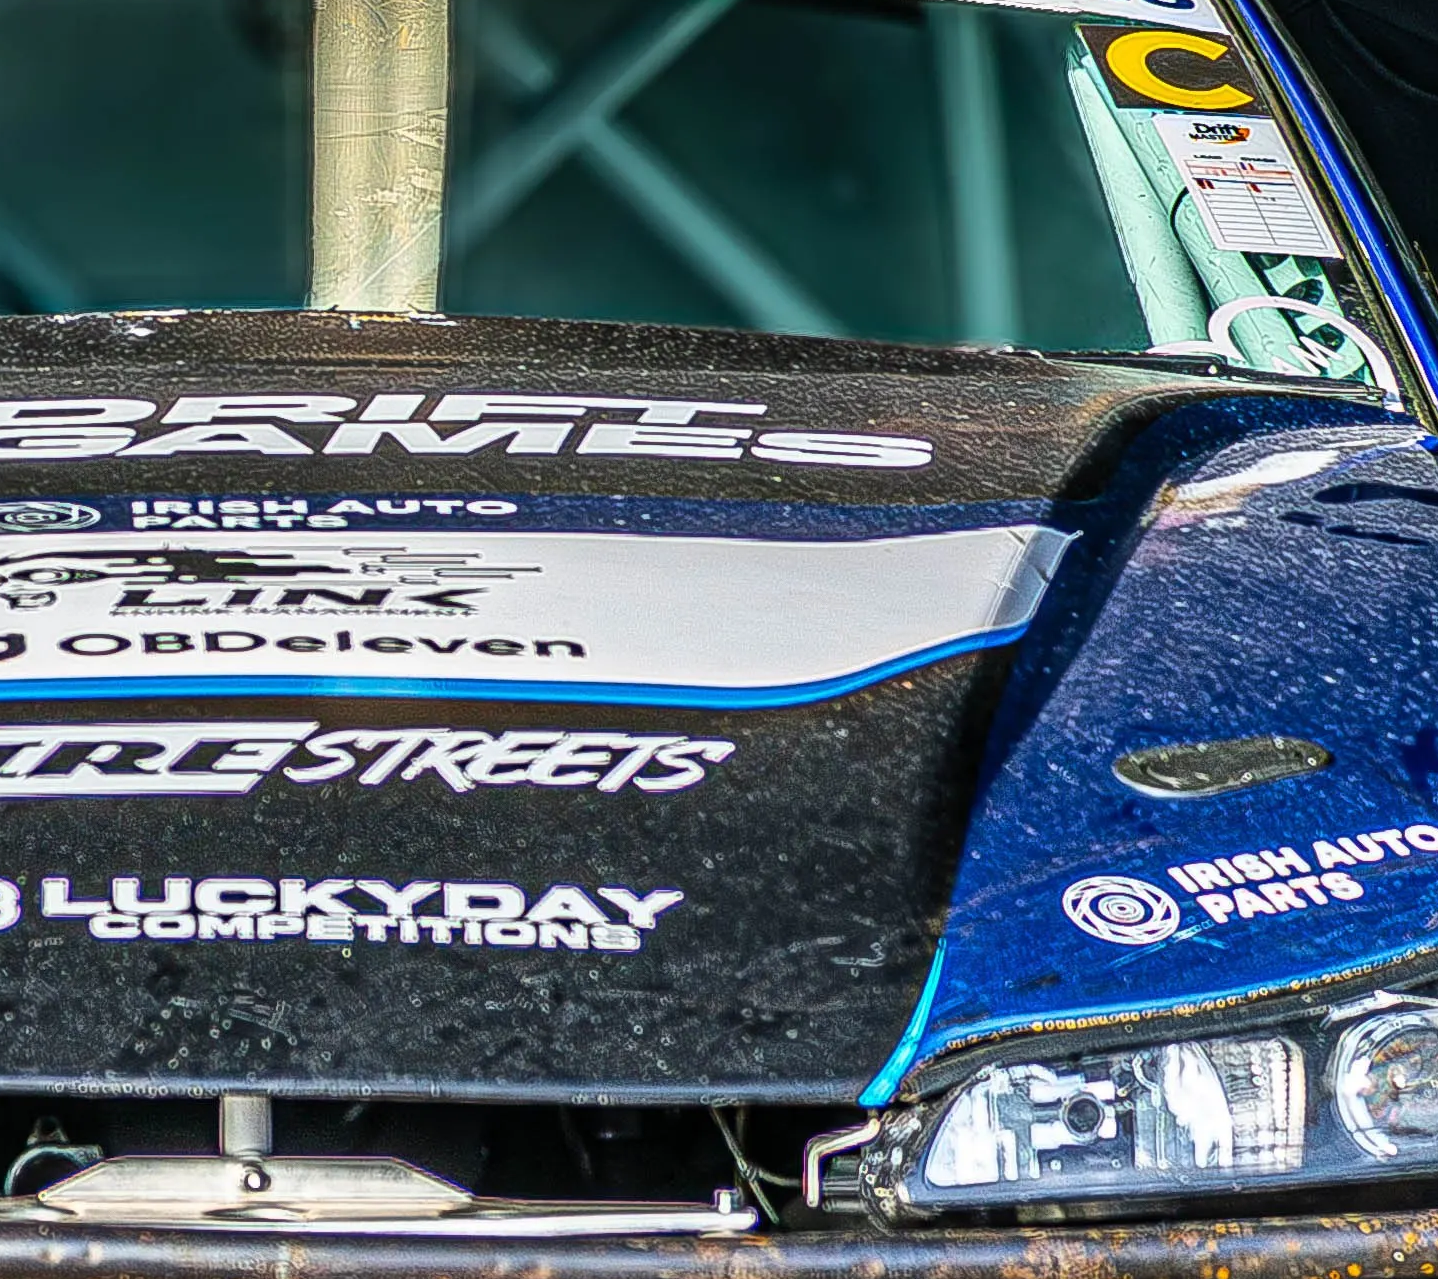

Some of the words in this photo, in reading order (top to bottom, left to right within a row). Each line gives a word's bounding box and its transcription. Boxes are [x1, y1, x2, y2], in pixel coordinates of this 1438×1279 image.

[1105, 30, 1255, 111] C
[131, 499, 310, 516] IRISH
[326, 498, 520, 516] AUTO
[131, 515, 350, 530] PARTS
[58, 631, 588, 659] OBDeleven
[284, 728, 737, 793] STREETS
[1166, 843, 1312, 895] IRISH
[40, 876, 685, 926] LUCKYDAY
[1195, 872, 1365, 924] PARTS
[87, 911, 640, 953] COMPETITIONS
